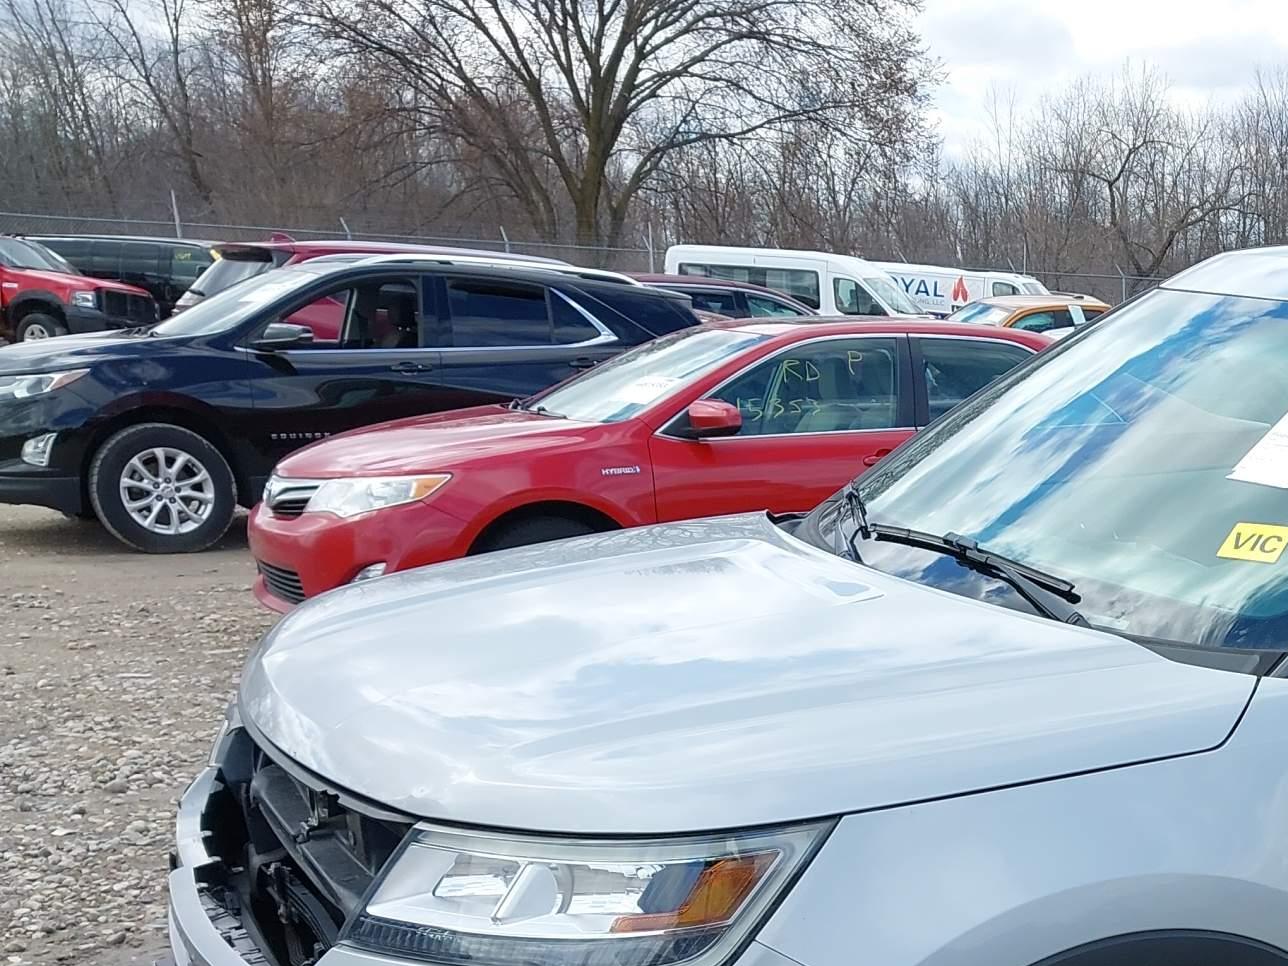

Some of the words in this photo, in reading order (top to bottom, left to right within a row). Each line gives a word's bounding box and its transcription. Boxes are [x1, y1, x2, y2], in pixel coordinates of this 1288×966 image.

[782, 359, 820, 383] RD
[601, 466, 635, 476] HYBRID
[1233, 531, 1284, 554] VIC
